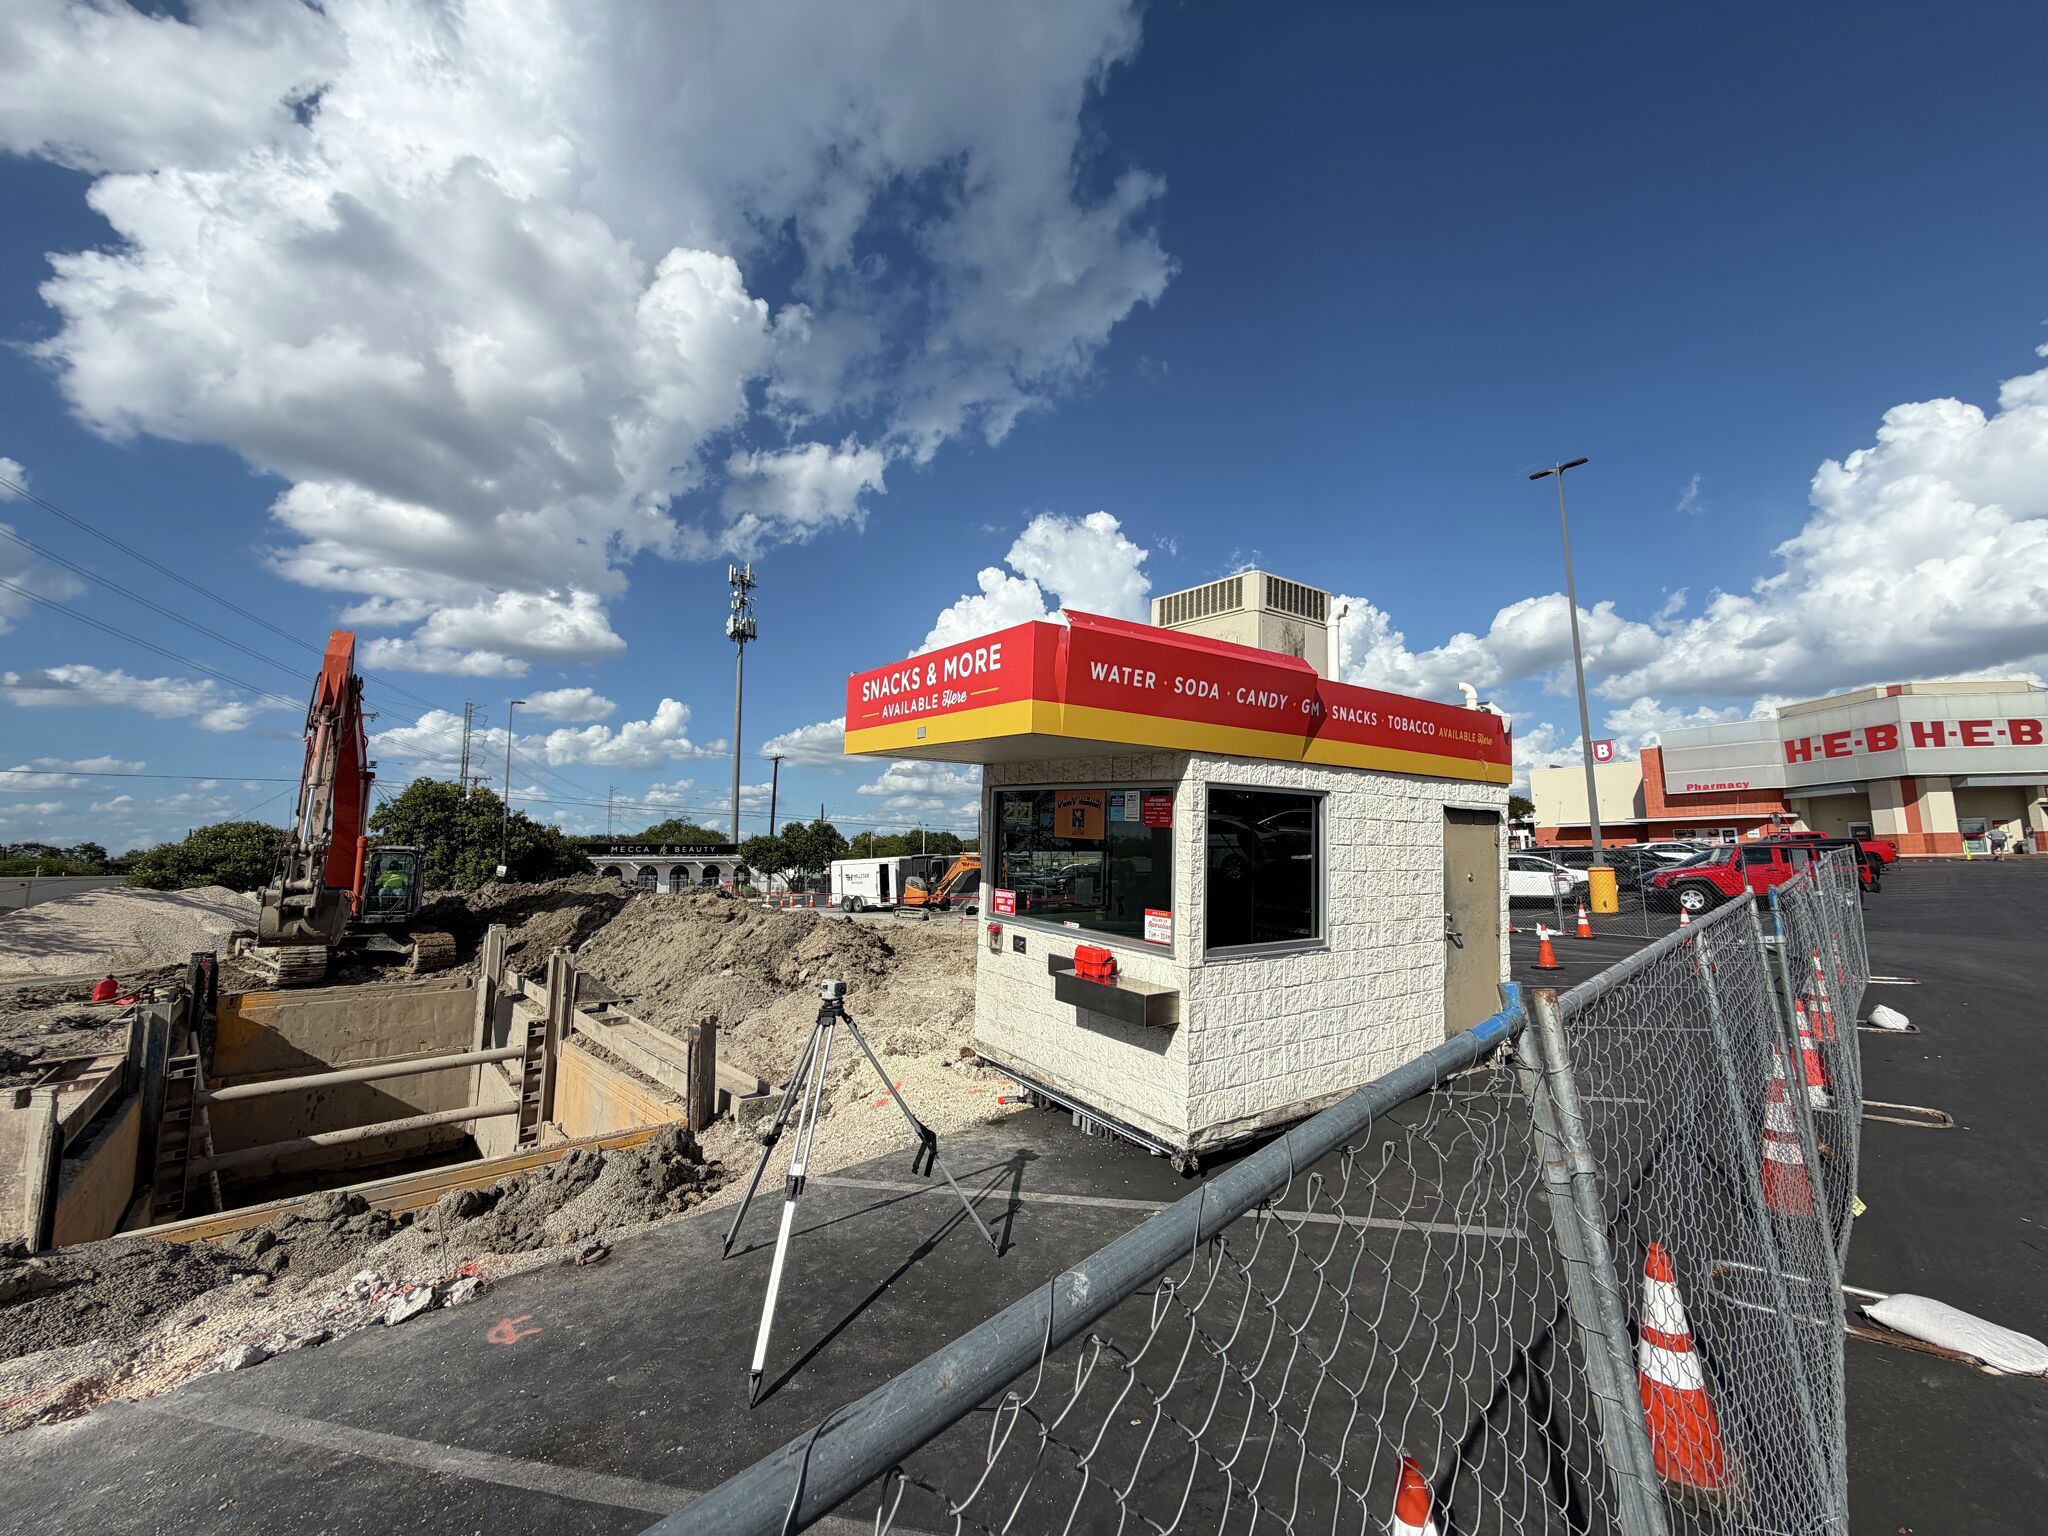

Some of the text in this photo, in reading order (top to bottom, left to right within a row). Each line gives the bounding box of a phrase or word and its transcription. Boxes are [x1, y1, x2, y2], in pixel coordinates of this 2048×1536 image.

[862, 643, 1002, 702] SNACKS & MORE
[882, 689, 967, 719] AVAILABLE Here
[1090, 661, 1156, 689] WATER
[1173, 676, 1220, 699] SODA
[1236, 687, 1289, 710] CANDY
[1332, 705, 1377, 726] SNACKS
[1387, 715, 1435, 736] TOBACCO
[1438, 727, 1476, 743] AVAILABLE
[1597, 744, 1609, 758] B
[1686, 781, 1749, 791] Pharmacy
